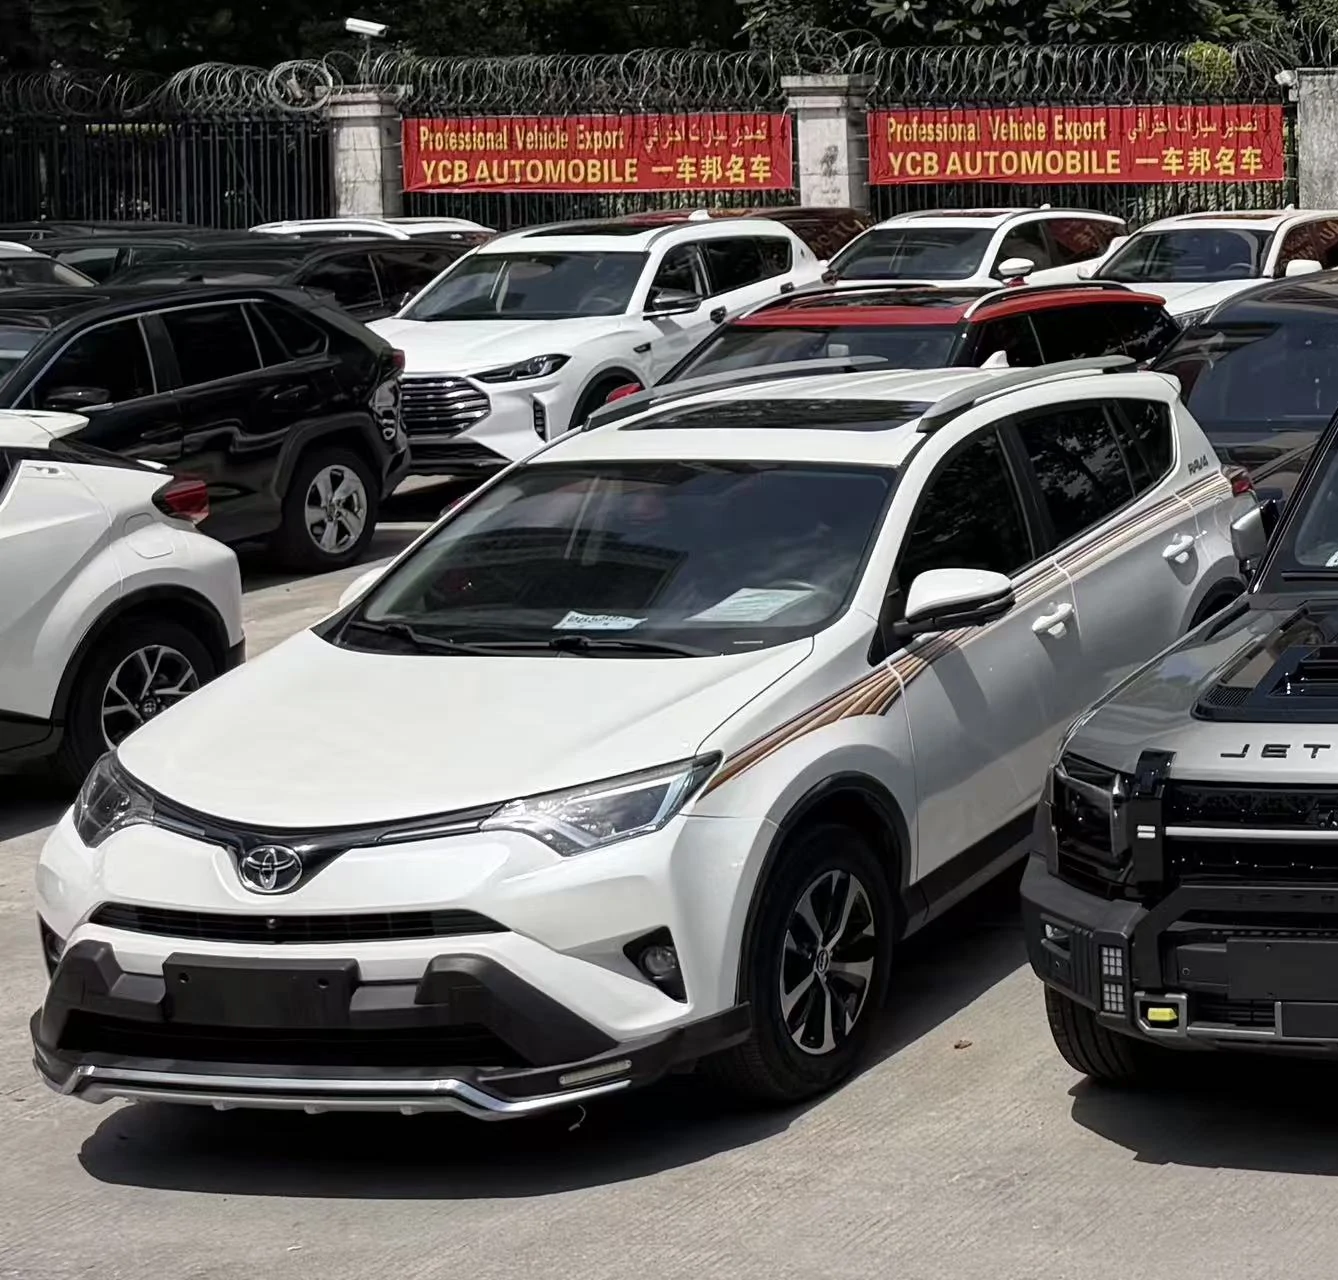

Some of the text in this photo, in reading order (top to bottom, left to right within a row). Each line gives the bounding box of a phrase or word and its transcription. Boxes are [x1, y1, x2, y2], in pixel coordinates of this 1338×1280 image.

[419, 124, 625, 154] Professional Vehicle Export
[887, 114, 1107, 145] Professional Vehicle Export
[421, 158, 638, 184] YCB AUTOMOBILE
[651, 154, 772, 184] 一车邦名车
[888, 150, 1121, 176] YCB AUTOMOBILE
[1135, 146, 1263, 176] 一车邦名车
